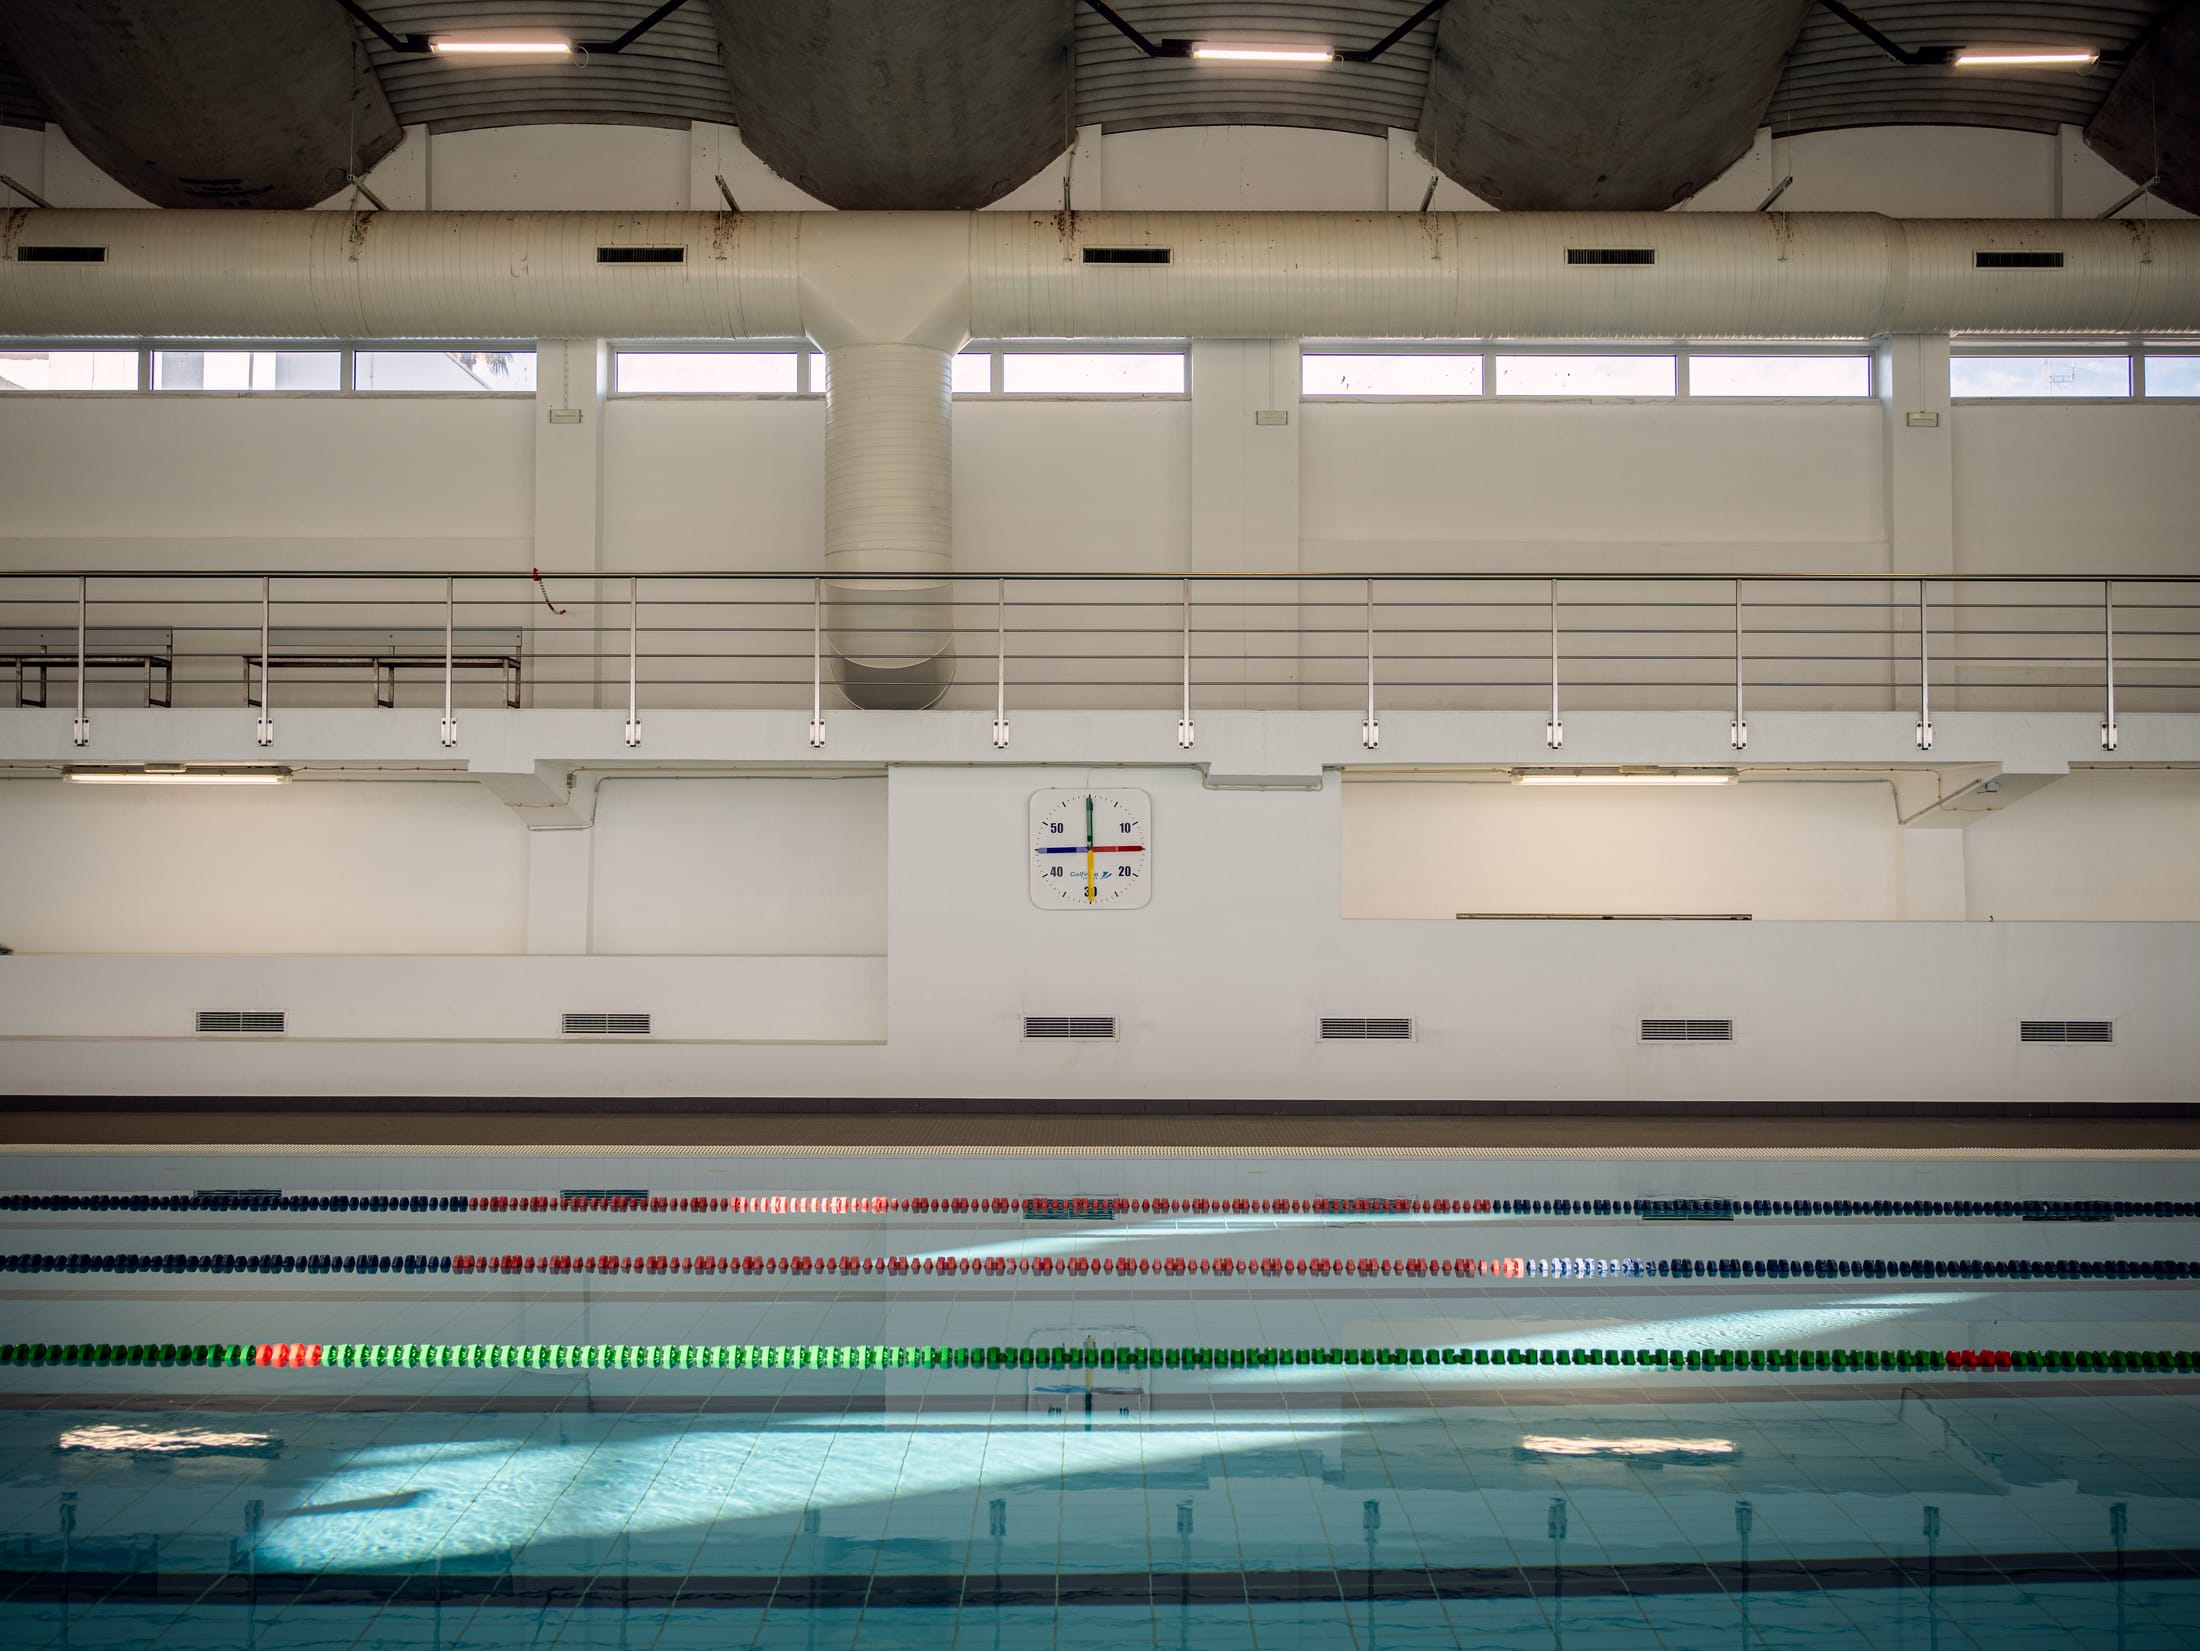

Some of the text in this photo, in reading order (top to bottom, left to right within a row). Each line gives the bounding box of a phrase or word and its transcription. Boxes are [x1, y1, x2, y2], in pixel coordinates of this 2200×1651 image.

[1050, 823, 1064, 833] 50
[1120, 823, 1131, 833] 10
[1050, 866, 1063, 877] 40
[1118, 866, 1131, 877] 20
